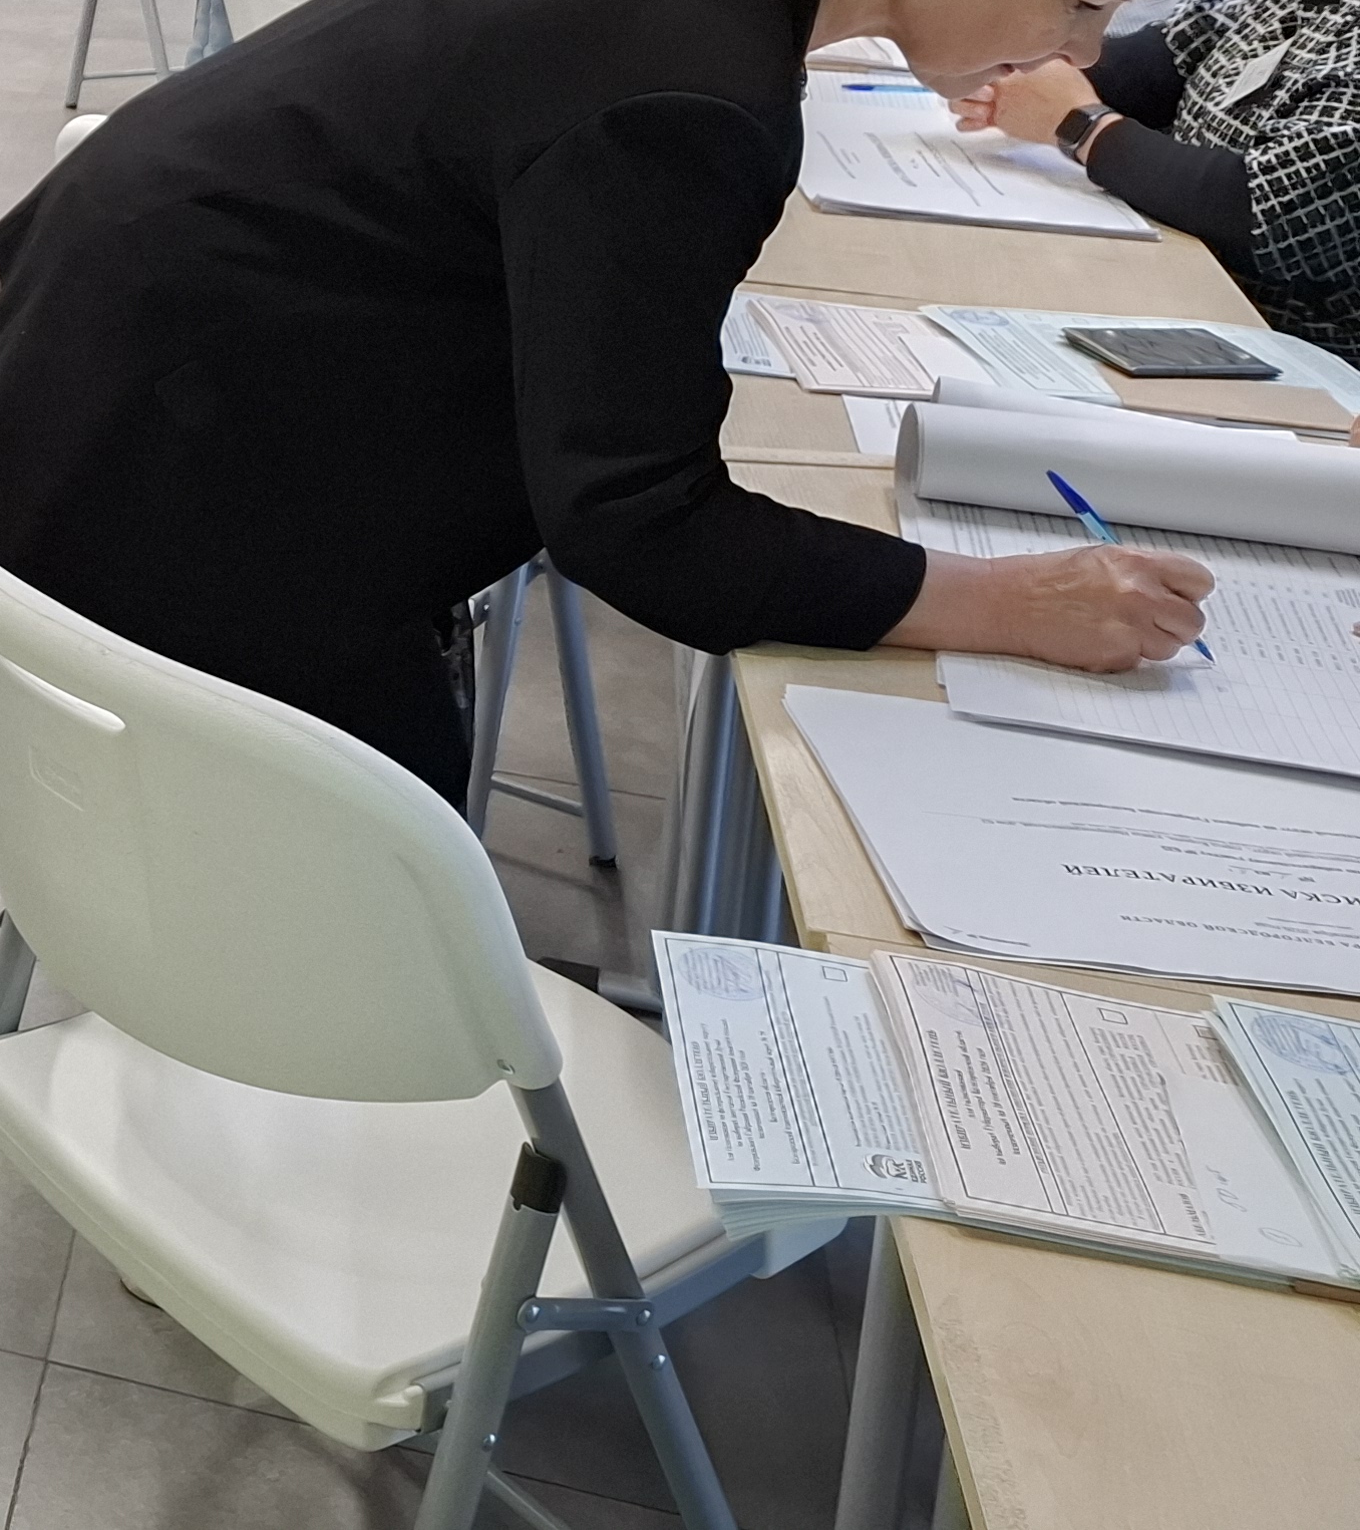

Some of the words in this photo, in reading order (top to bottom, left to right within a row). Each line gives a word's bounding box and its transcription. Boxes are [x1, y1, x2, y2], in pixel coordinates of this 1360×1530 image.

[1061, 863, 1275, 897] ИЗБИРАТЕЛЕЙ
[1120, 914, 1199, 929] ОБЛАСТИ
[1203, 923, 1336, 947] БЕЛГОРОДСКОЙ
